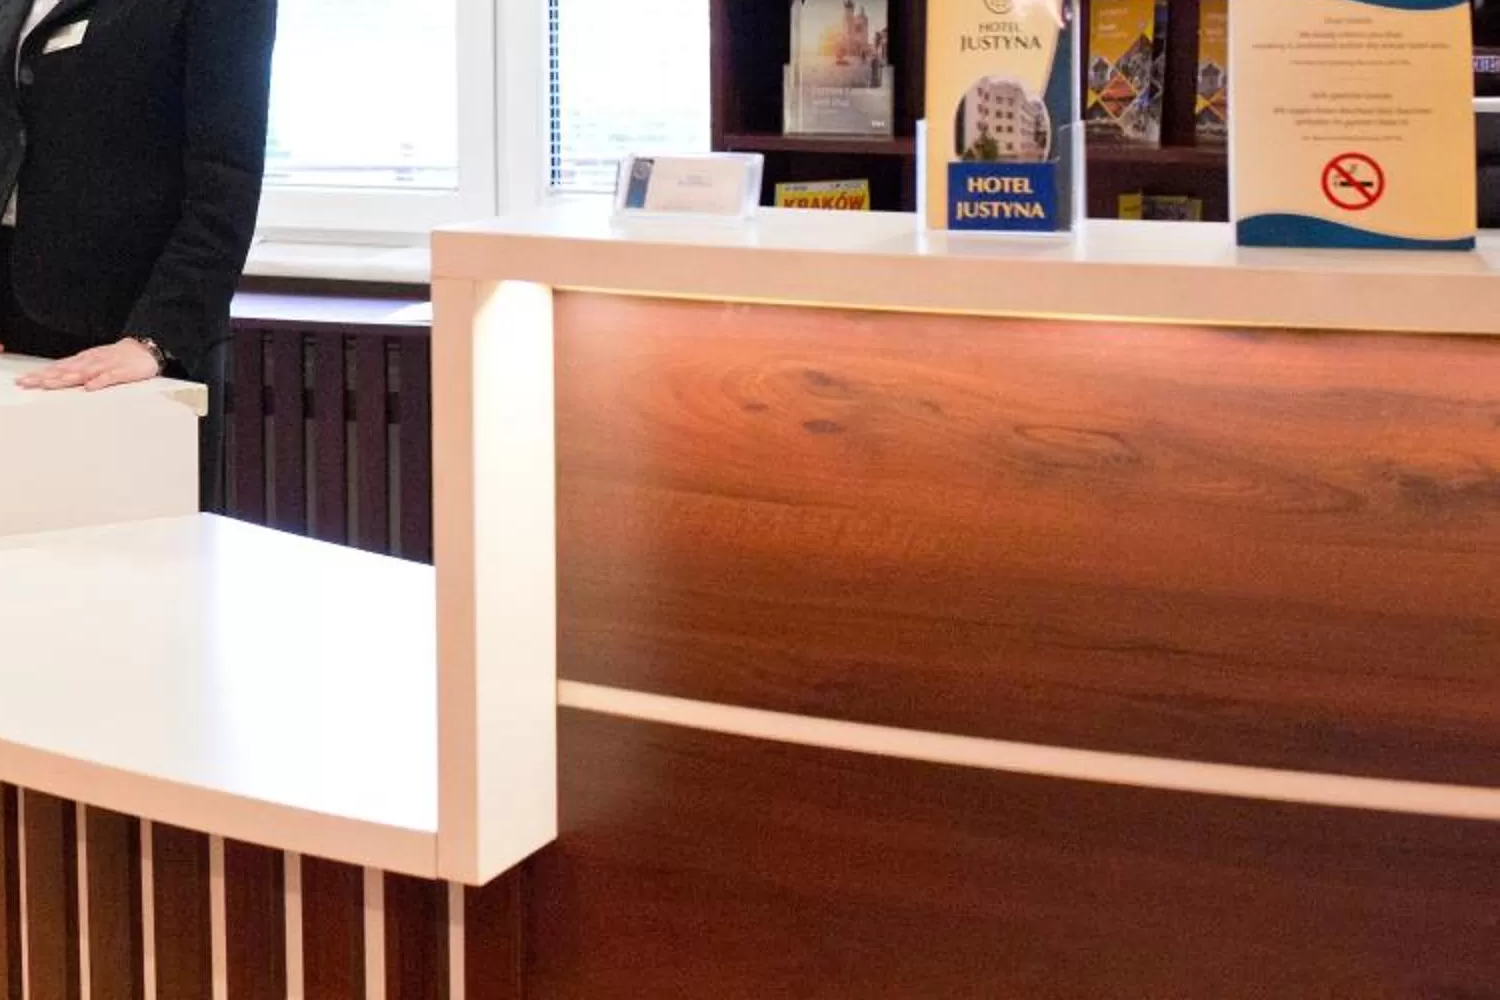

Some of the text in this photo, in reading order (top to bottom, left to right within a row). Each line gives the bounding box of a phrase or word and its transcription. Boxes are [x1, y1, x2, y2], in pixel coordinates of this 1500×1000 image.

[979, 21, 1022, 33] HOTEL
[960, 36, 1042, 52] JUSTYNA
[967, 176, 1034, 194] HOTEL
[955, 201, 1046, 220] JUSTYNA
